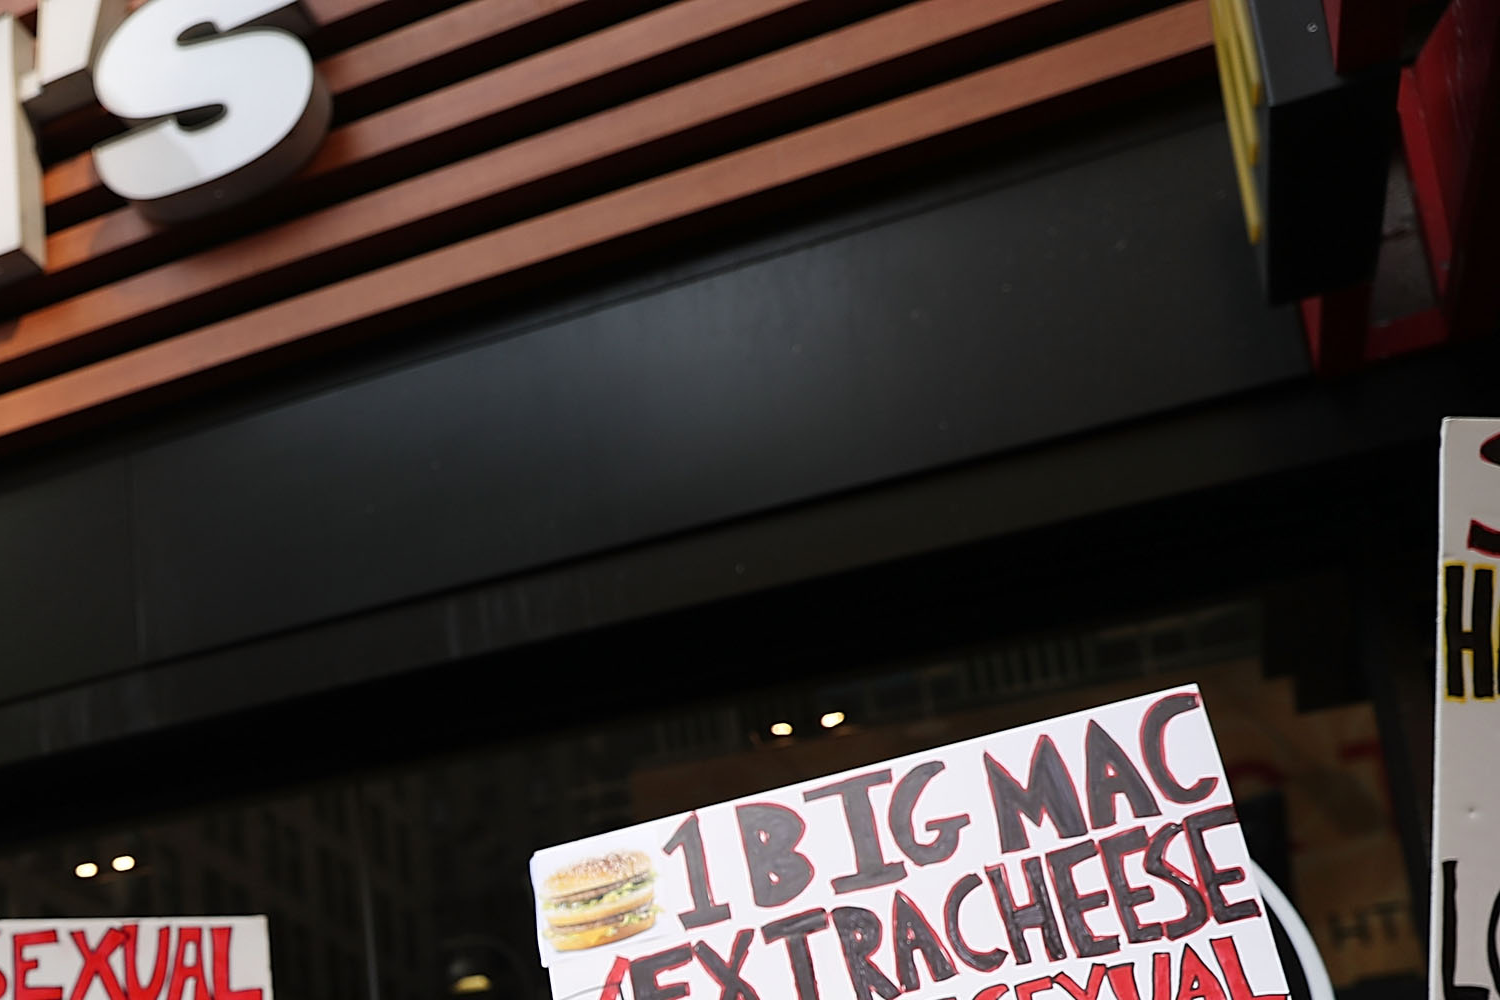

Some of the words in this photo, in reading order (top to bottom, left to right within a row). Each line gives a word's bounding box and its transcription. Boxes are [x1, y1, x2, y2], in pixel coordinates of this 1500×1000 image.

[662, 810, 731, 930] 1
[735, 760, 971, 908] BIG
[984, 692, 1219, 854] MAC
[944, 804, 1262, 972] CHEESE
